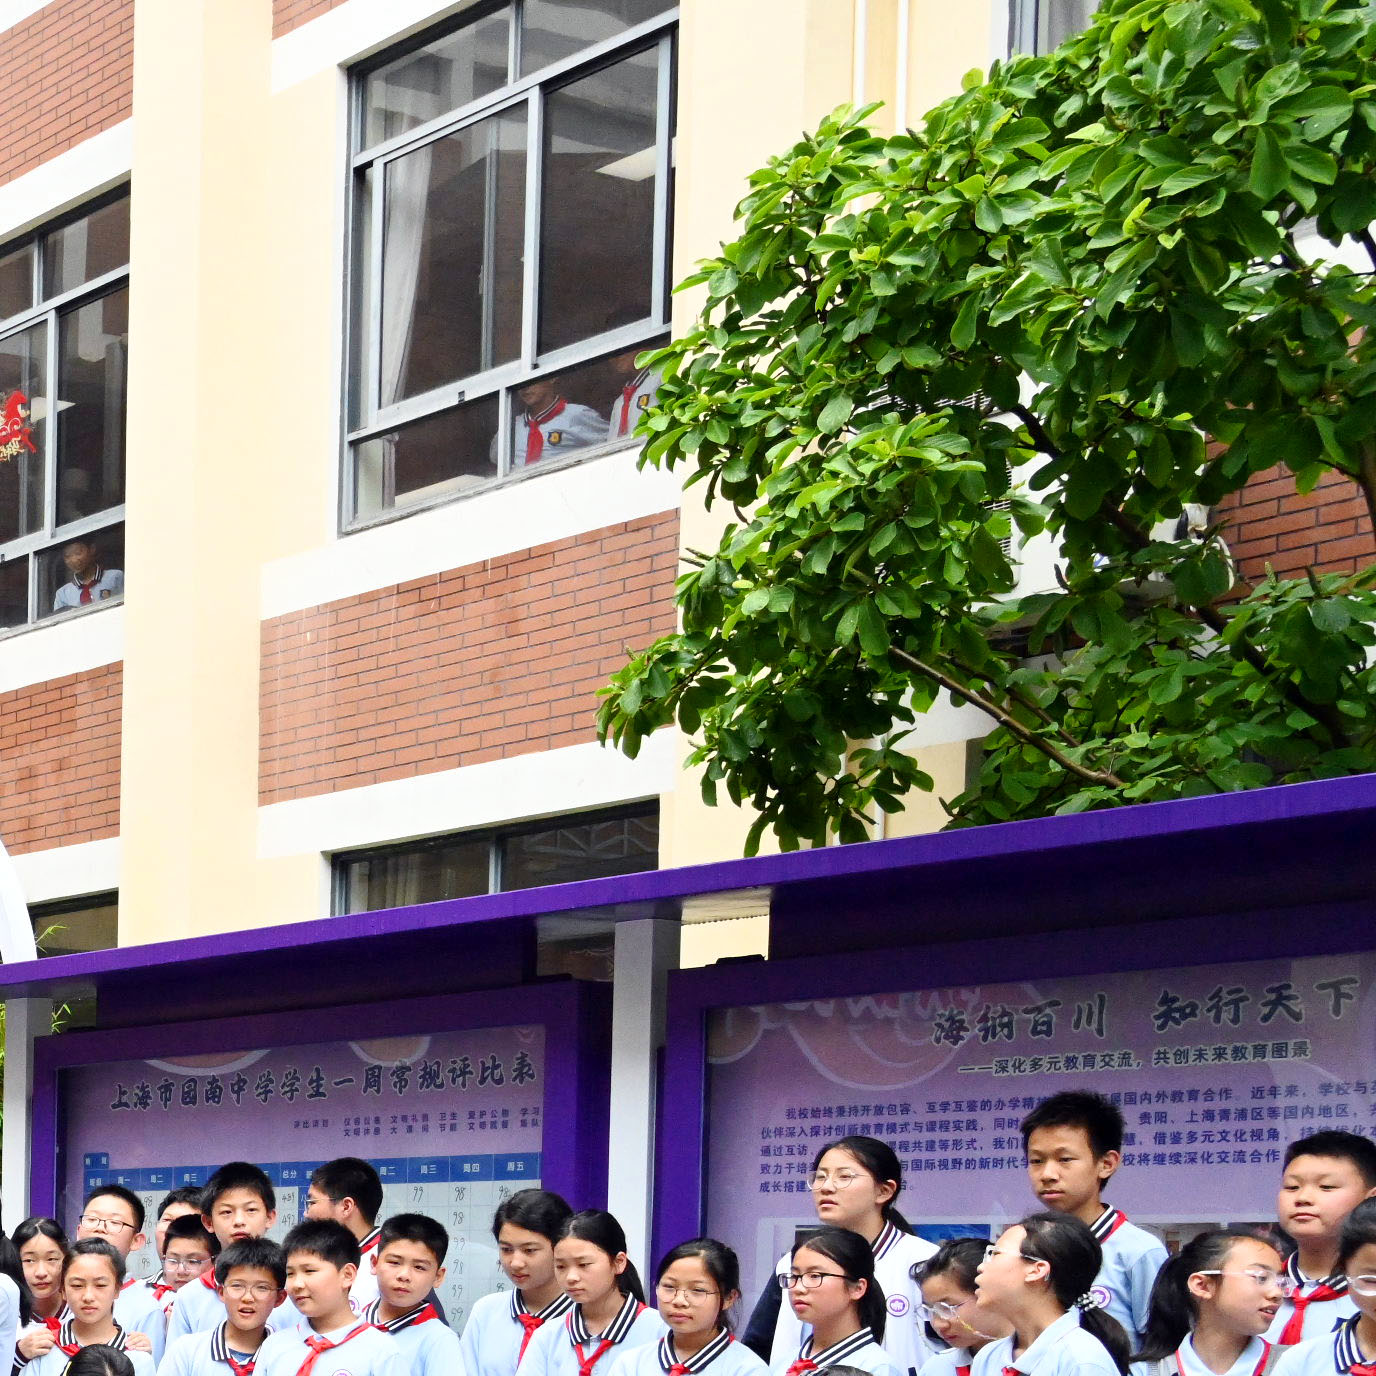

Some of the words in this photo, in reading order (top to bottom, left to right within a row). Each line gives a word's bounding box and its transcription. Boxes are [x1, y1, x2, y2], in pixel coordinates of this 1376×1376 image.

[933, 993, 1107, 1046] 海纳百川
[1153, 976, 1360, 1031] 知行天下
[110, 1051, 536, 1112] 上海市园南中学学生一周常规评比表
[282, 1169, 297, 1179] 总分
[379, 1166, 396, 1176] 周二
[420, 1164, 437, 1174] 周三
[463, 1163, 480, 1173] 周四
[507, 1161, 524, 1171] 周五
[759, 1180, 813, 1194] 成长搭建
